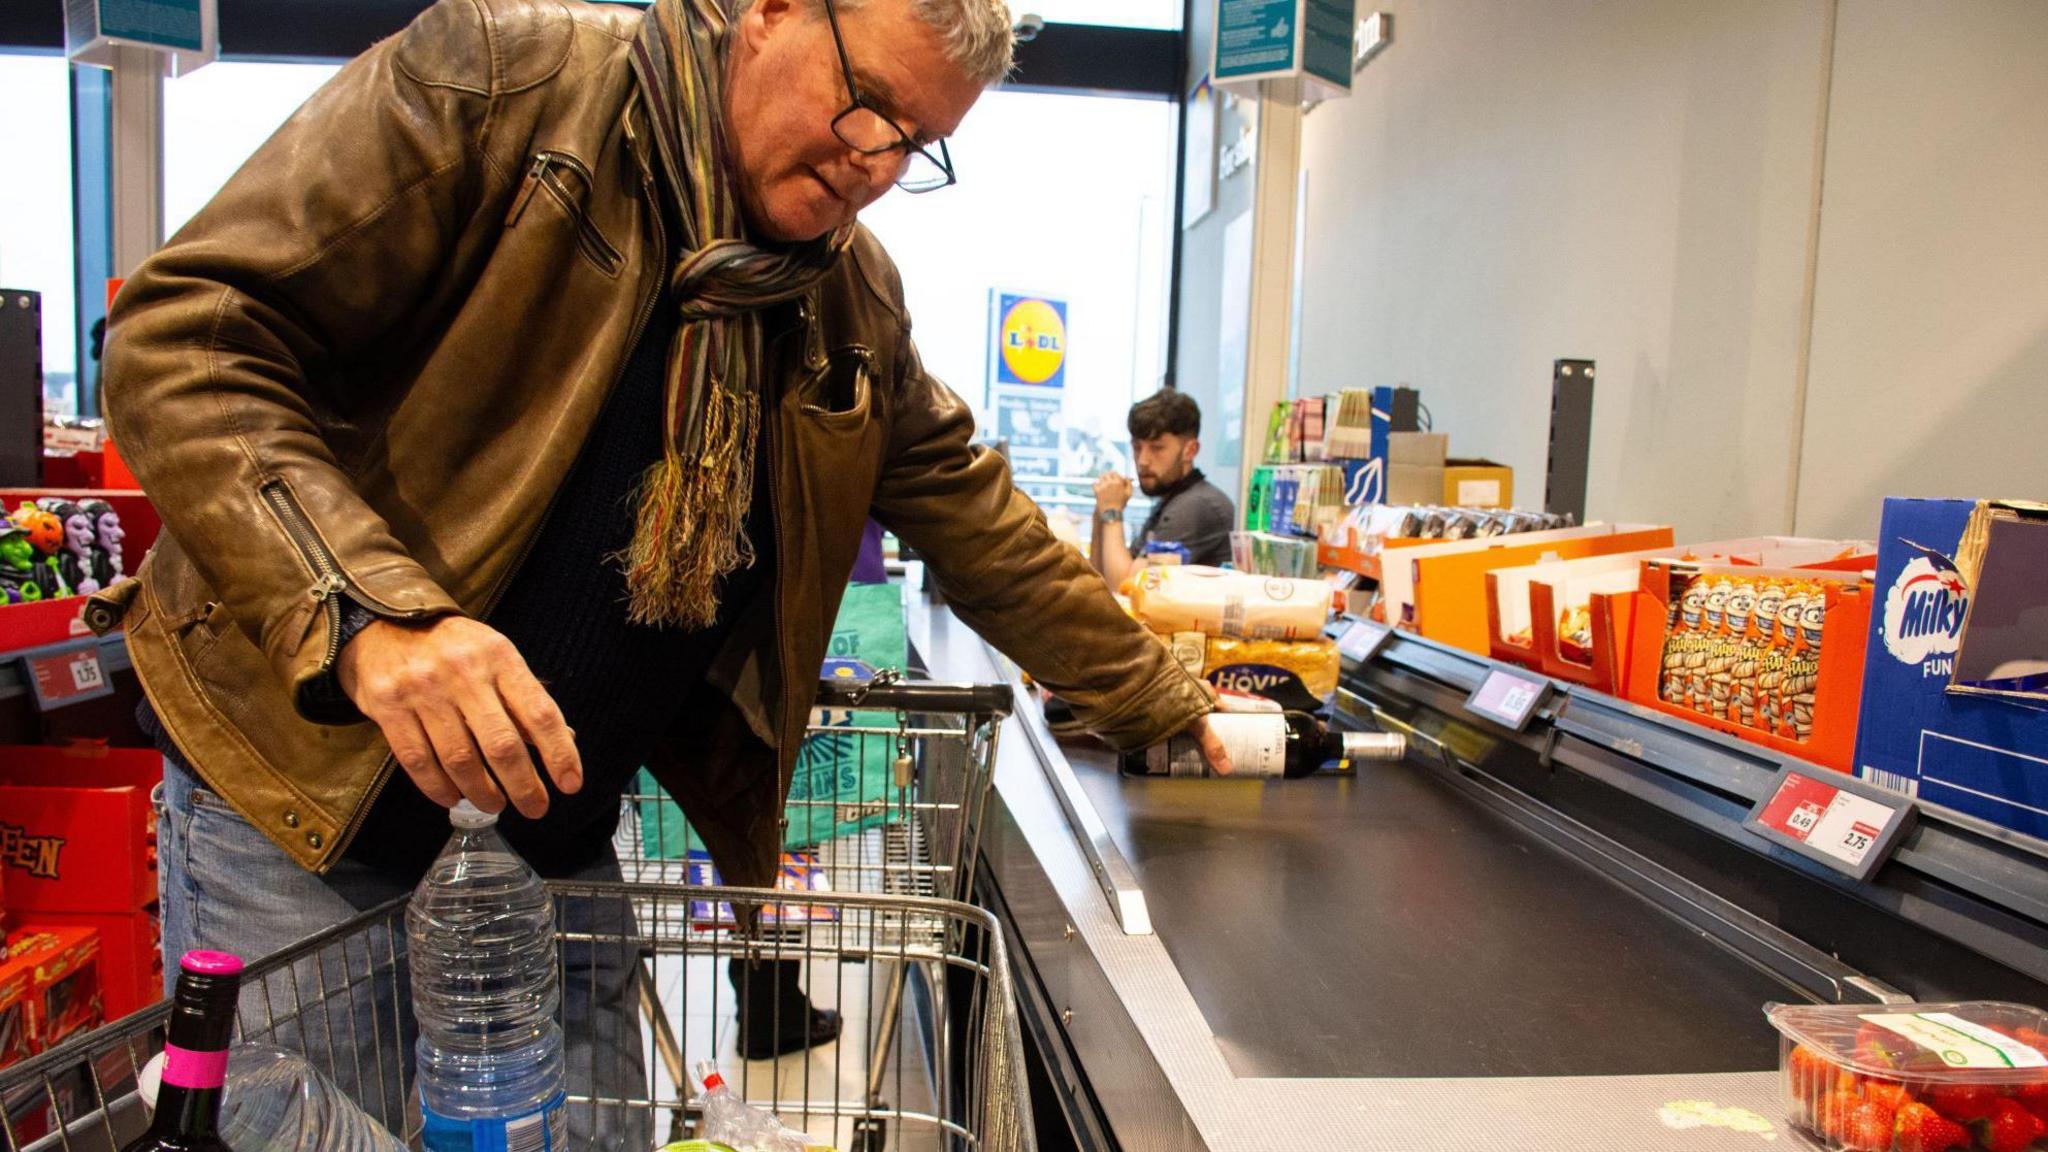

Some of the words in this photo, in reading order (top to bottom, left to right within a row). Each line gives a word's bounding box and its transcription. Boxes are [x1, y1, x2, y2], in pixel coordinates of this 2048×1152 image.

[1899, 588, 1968, 639] Milky
[832, 634, 860, 656] OF
[1922, 658, 1952, 678] FUN
[1791, 813, 1812, 829] 0.49
[1843, 832, 1868, 850] 2.75
